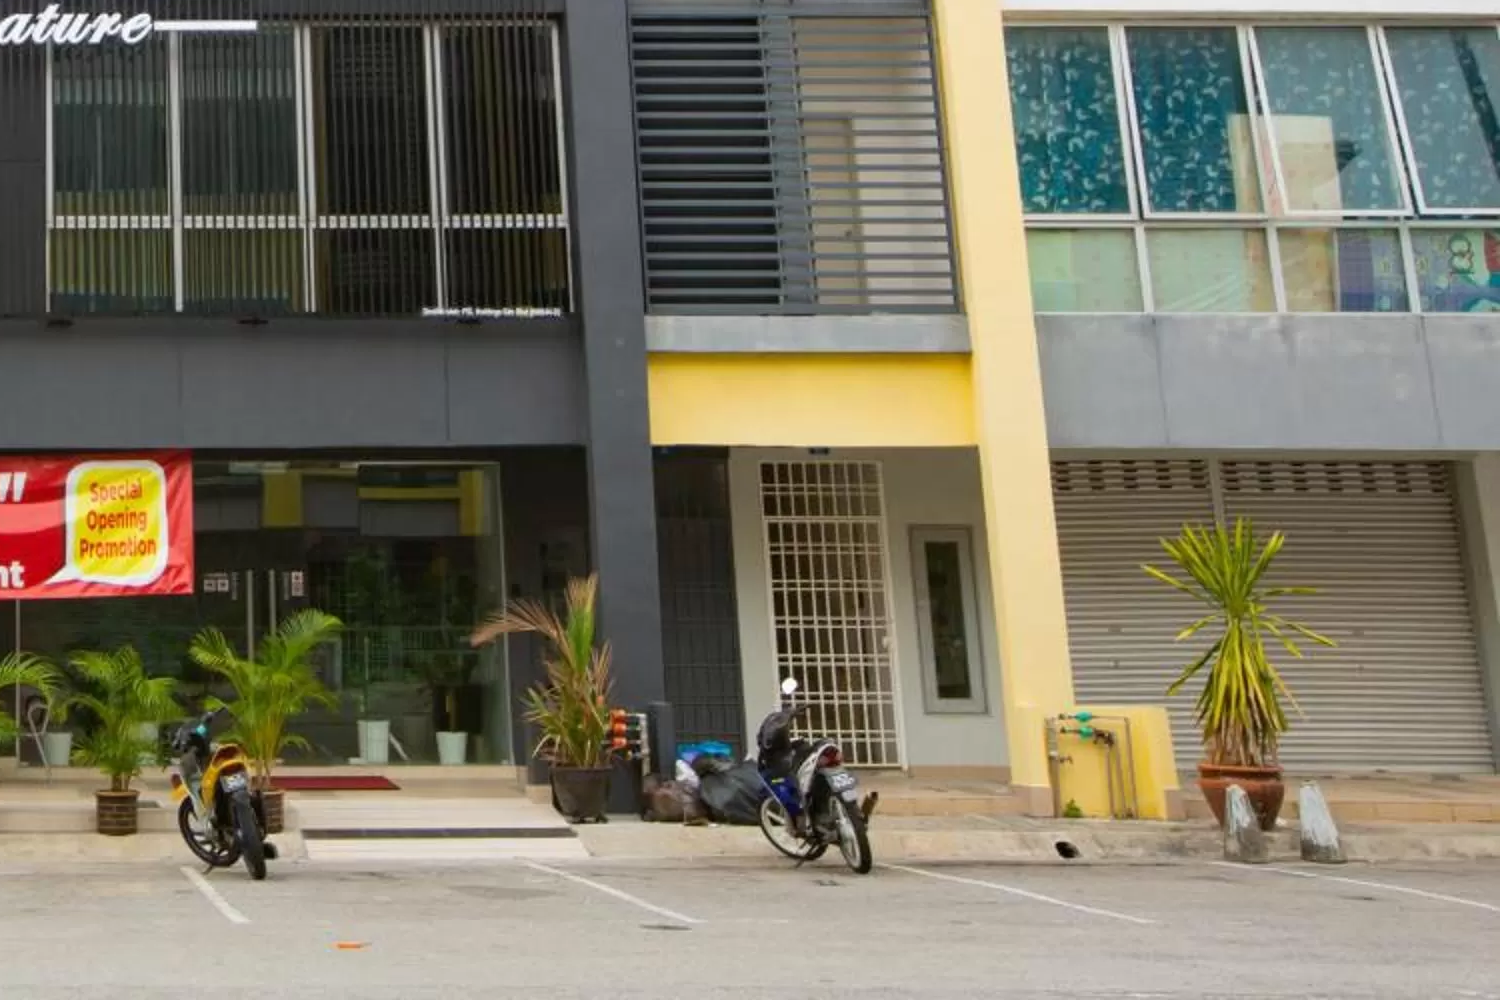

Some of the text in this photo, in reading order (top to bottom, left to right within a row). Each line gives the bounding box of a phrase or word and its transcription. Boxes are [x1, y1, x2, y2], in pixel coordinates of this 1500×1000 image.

[89, 477, 143, 503] Special
[86, 504, 148, 534] Opening
[79, 535, 156, 559] Promotion
